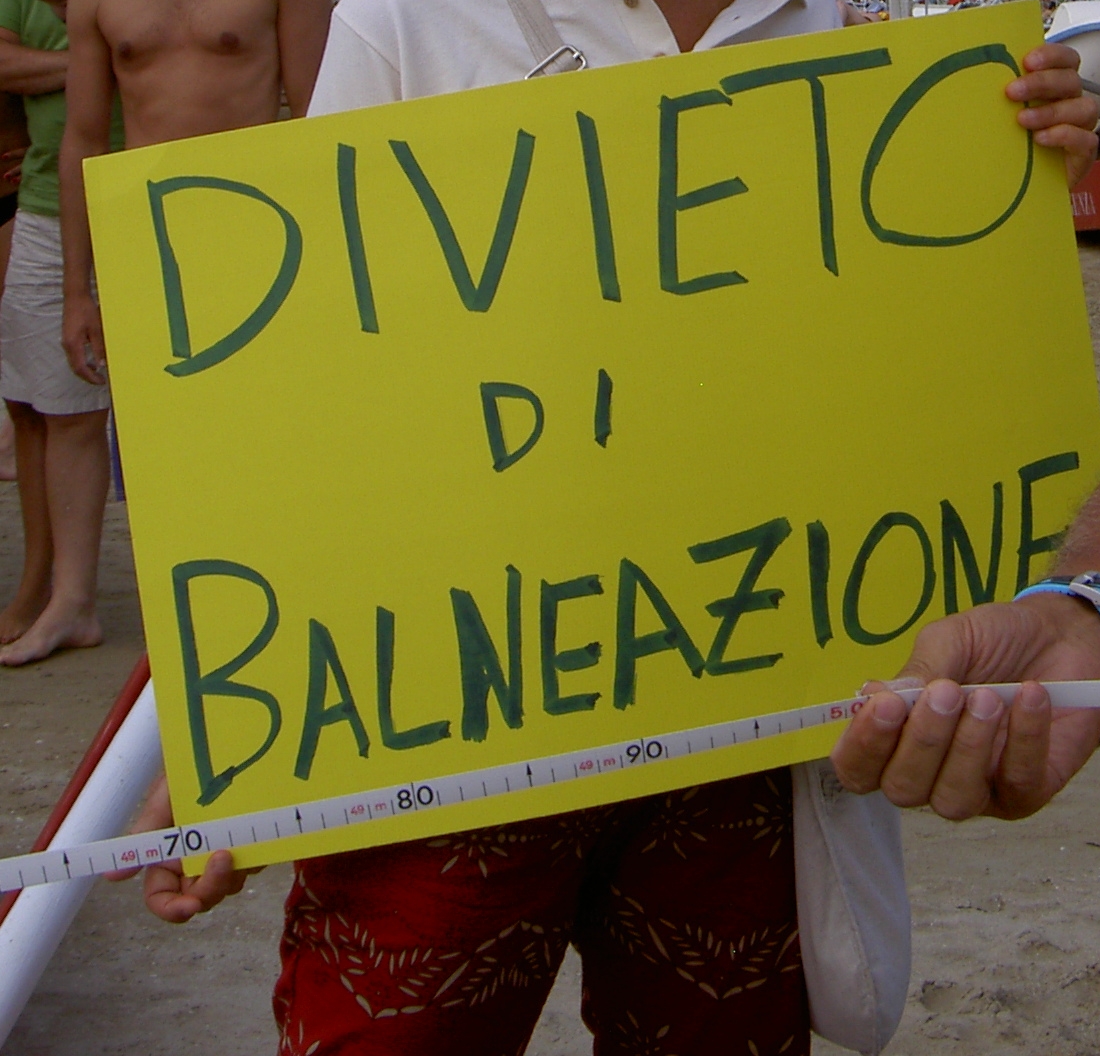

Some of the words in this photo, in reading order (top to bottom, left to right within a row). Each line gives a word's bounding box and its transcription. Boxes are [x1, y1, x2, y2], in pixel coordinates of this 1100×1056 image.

[147, 43, 1031, 376] DIVIETO
[480, 368, 612, 472] DI
[170, 452, 1078, 806] BALNEAZIONE
[121, 850, 136, 862] 49
[145, 848, 158, 858] m
[163, 829, 202, 856] 70
[350, 804, 365, 816] 49
[375, 802, 387, 811] m
[397, 785, 434, 809] 80
[579, 760, 594, 770] 49
[603, 757, 616, 766] m
[626, 740, 662, 763] 90
